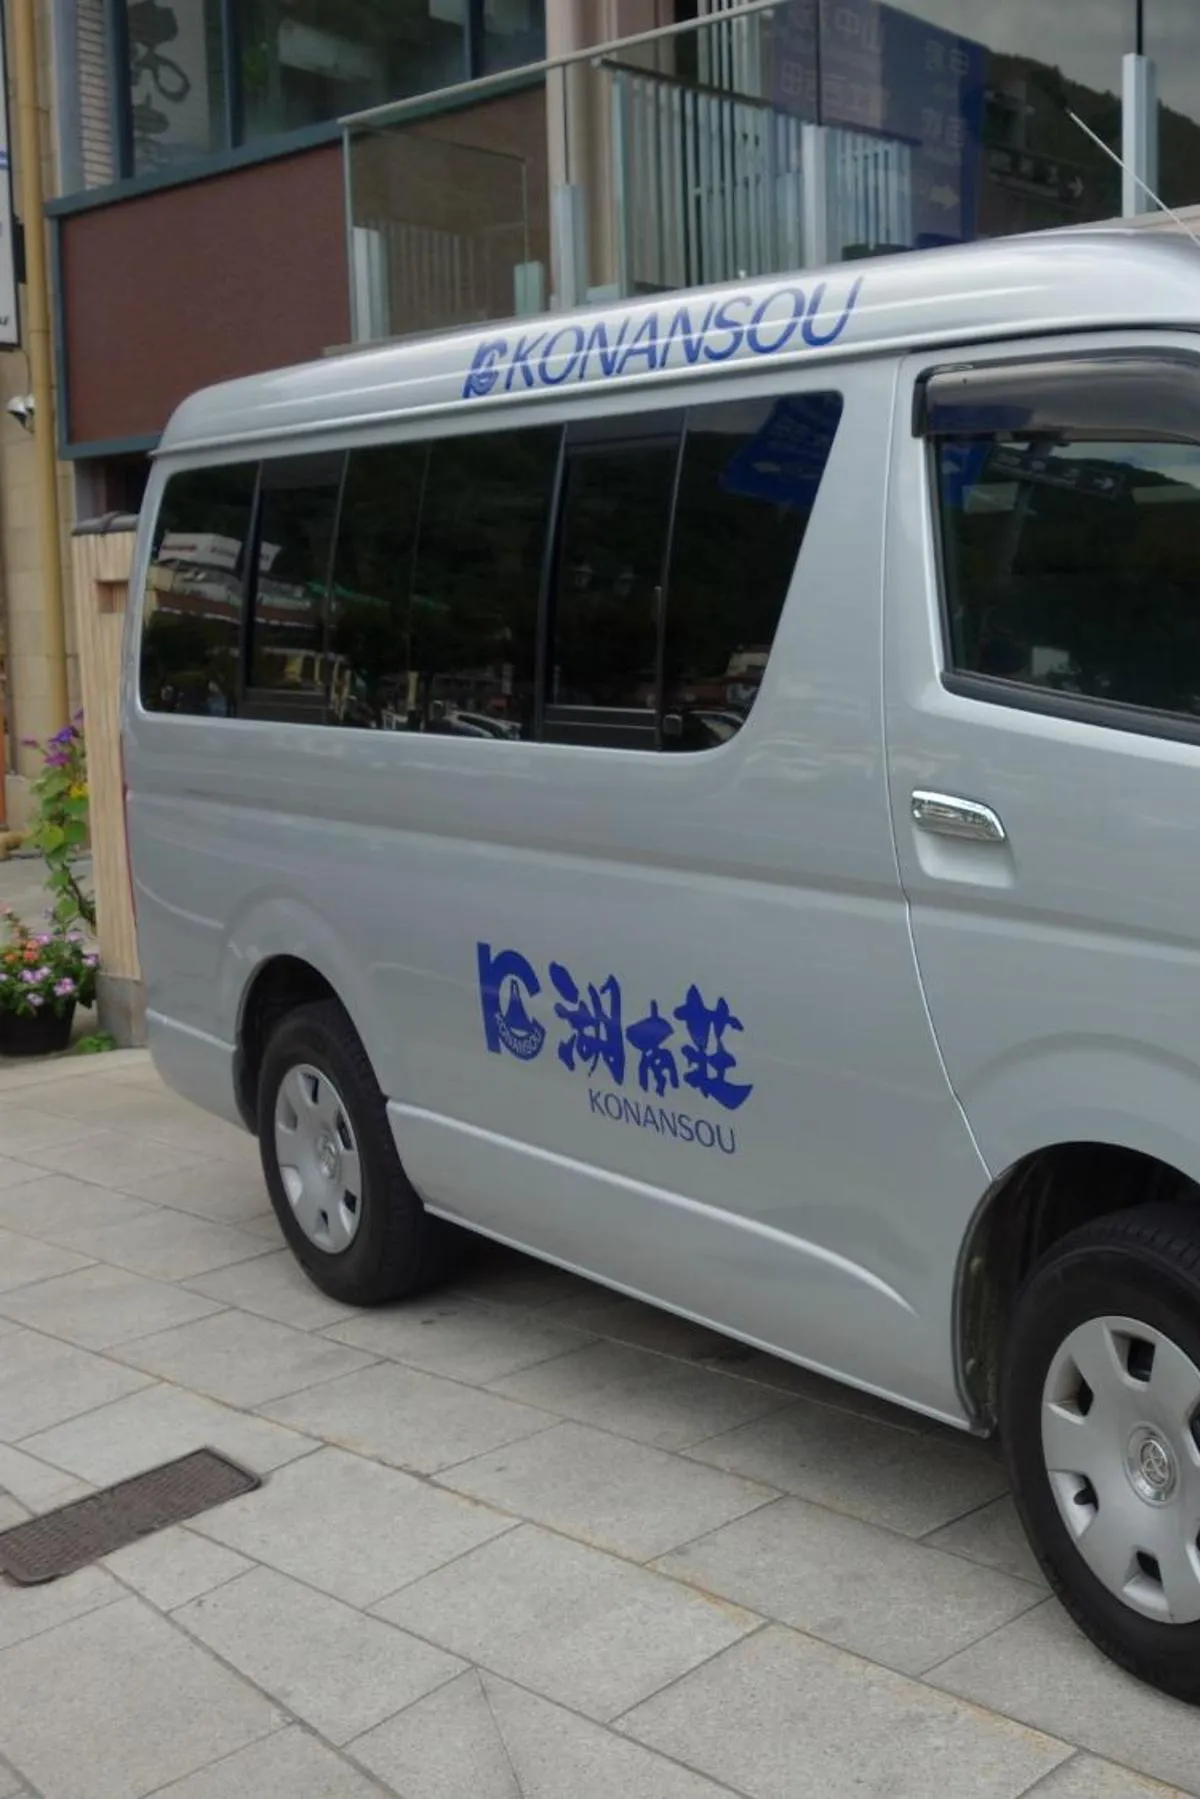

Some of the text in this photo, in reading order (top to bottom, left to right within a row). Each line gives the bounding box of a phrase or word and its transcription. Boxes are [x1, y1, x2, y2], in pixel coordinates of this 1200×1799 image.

[504, 275, 865, 391] KONANSOU
[548, 960, 753, 1110] 湖南荘
[588, 1088, 736, 1154] KONANSOU
